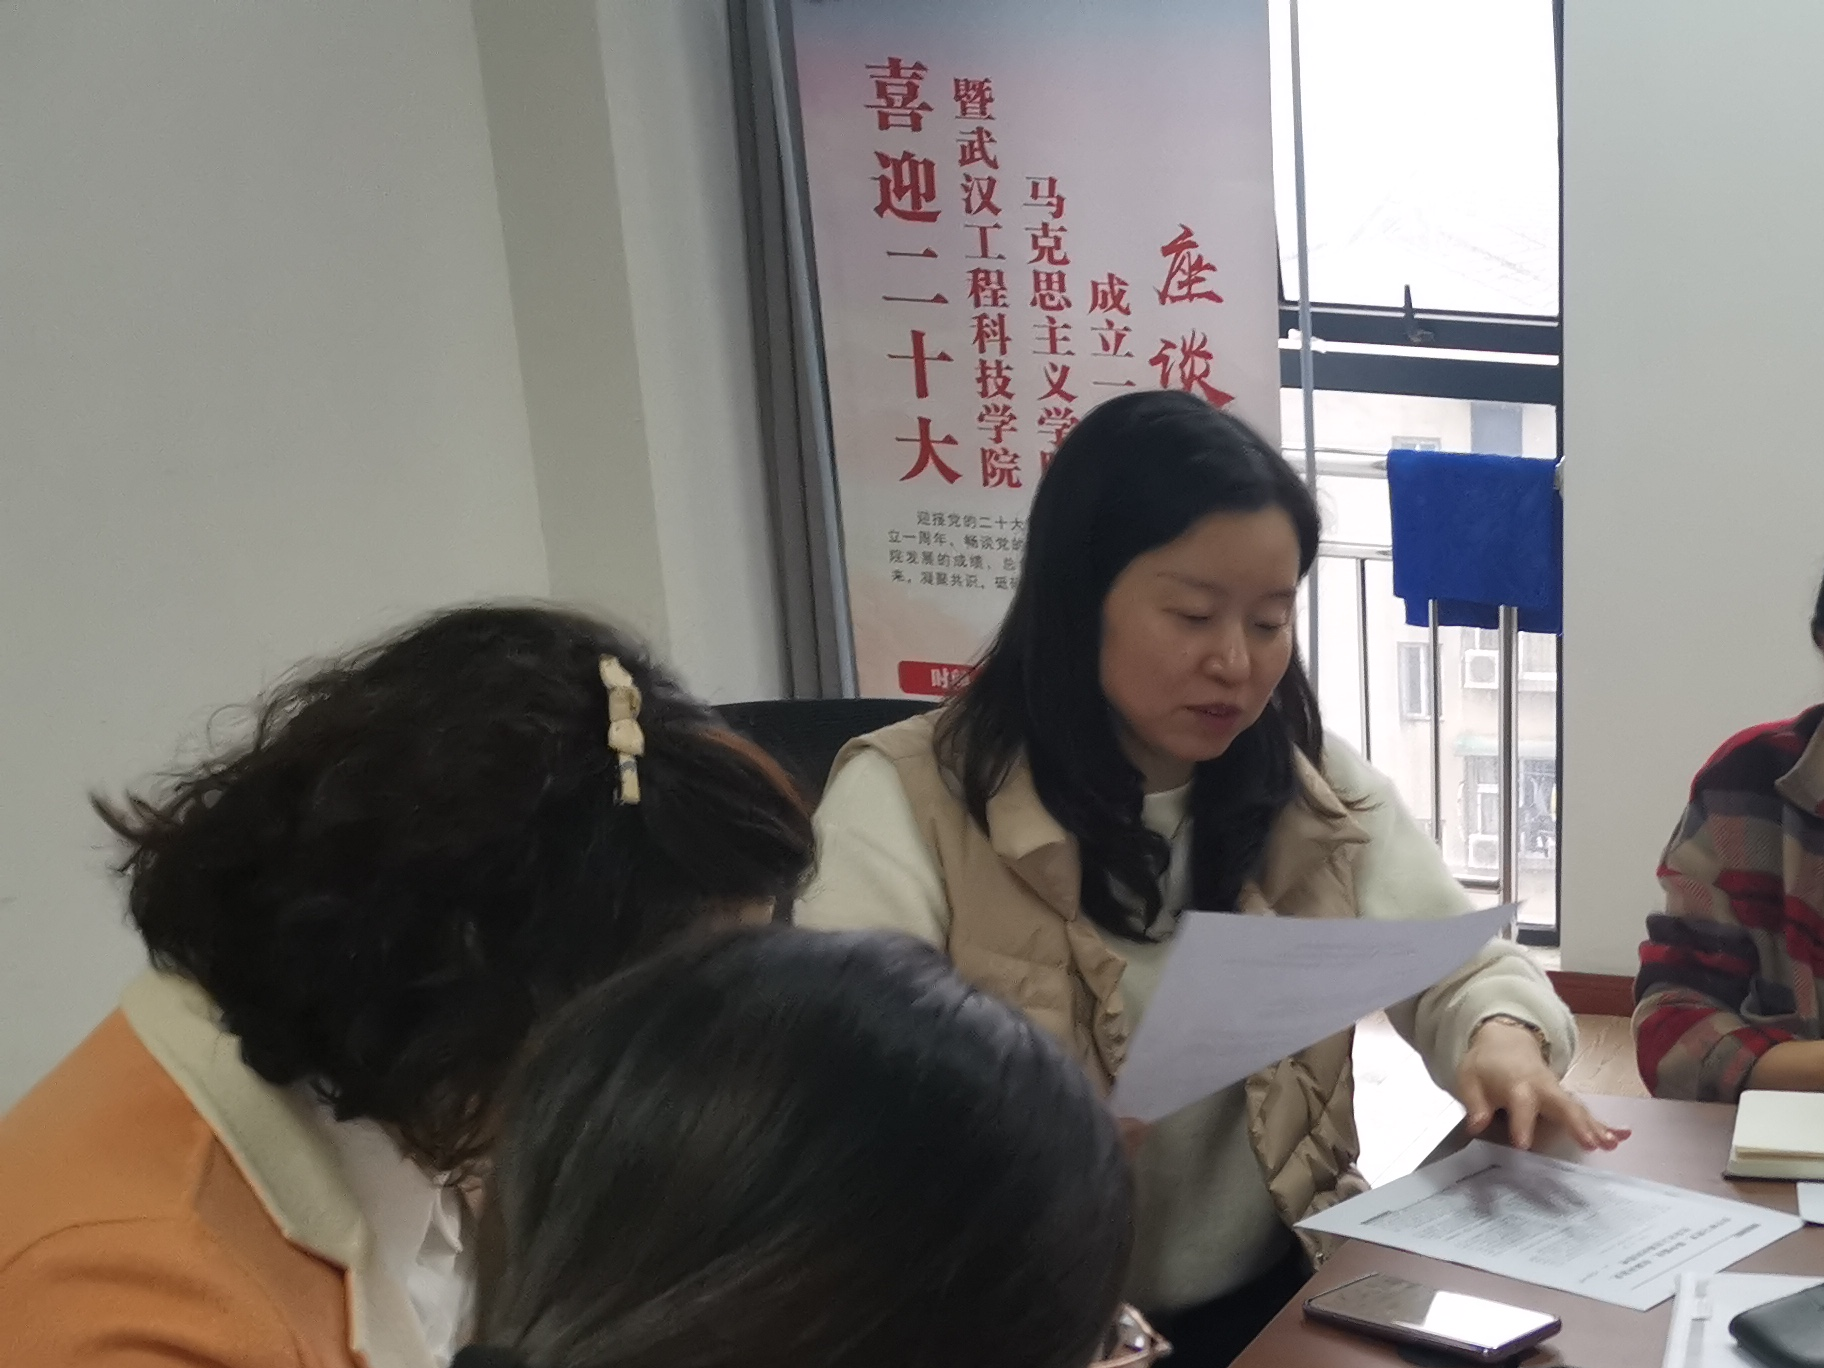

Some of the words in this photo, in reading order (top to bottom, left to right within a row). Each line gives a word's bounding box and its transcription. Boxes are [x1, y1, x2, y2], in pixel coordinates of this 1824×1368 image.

[864, 57, 962, 485] 喜迎二十大
[952, 76, 1024, 489] 暨武汉工程科技学院
[1089, 272, 1136, 388] 成立一
